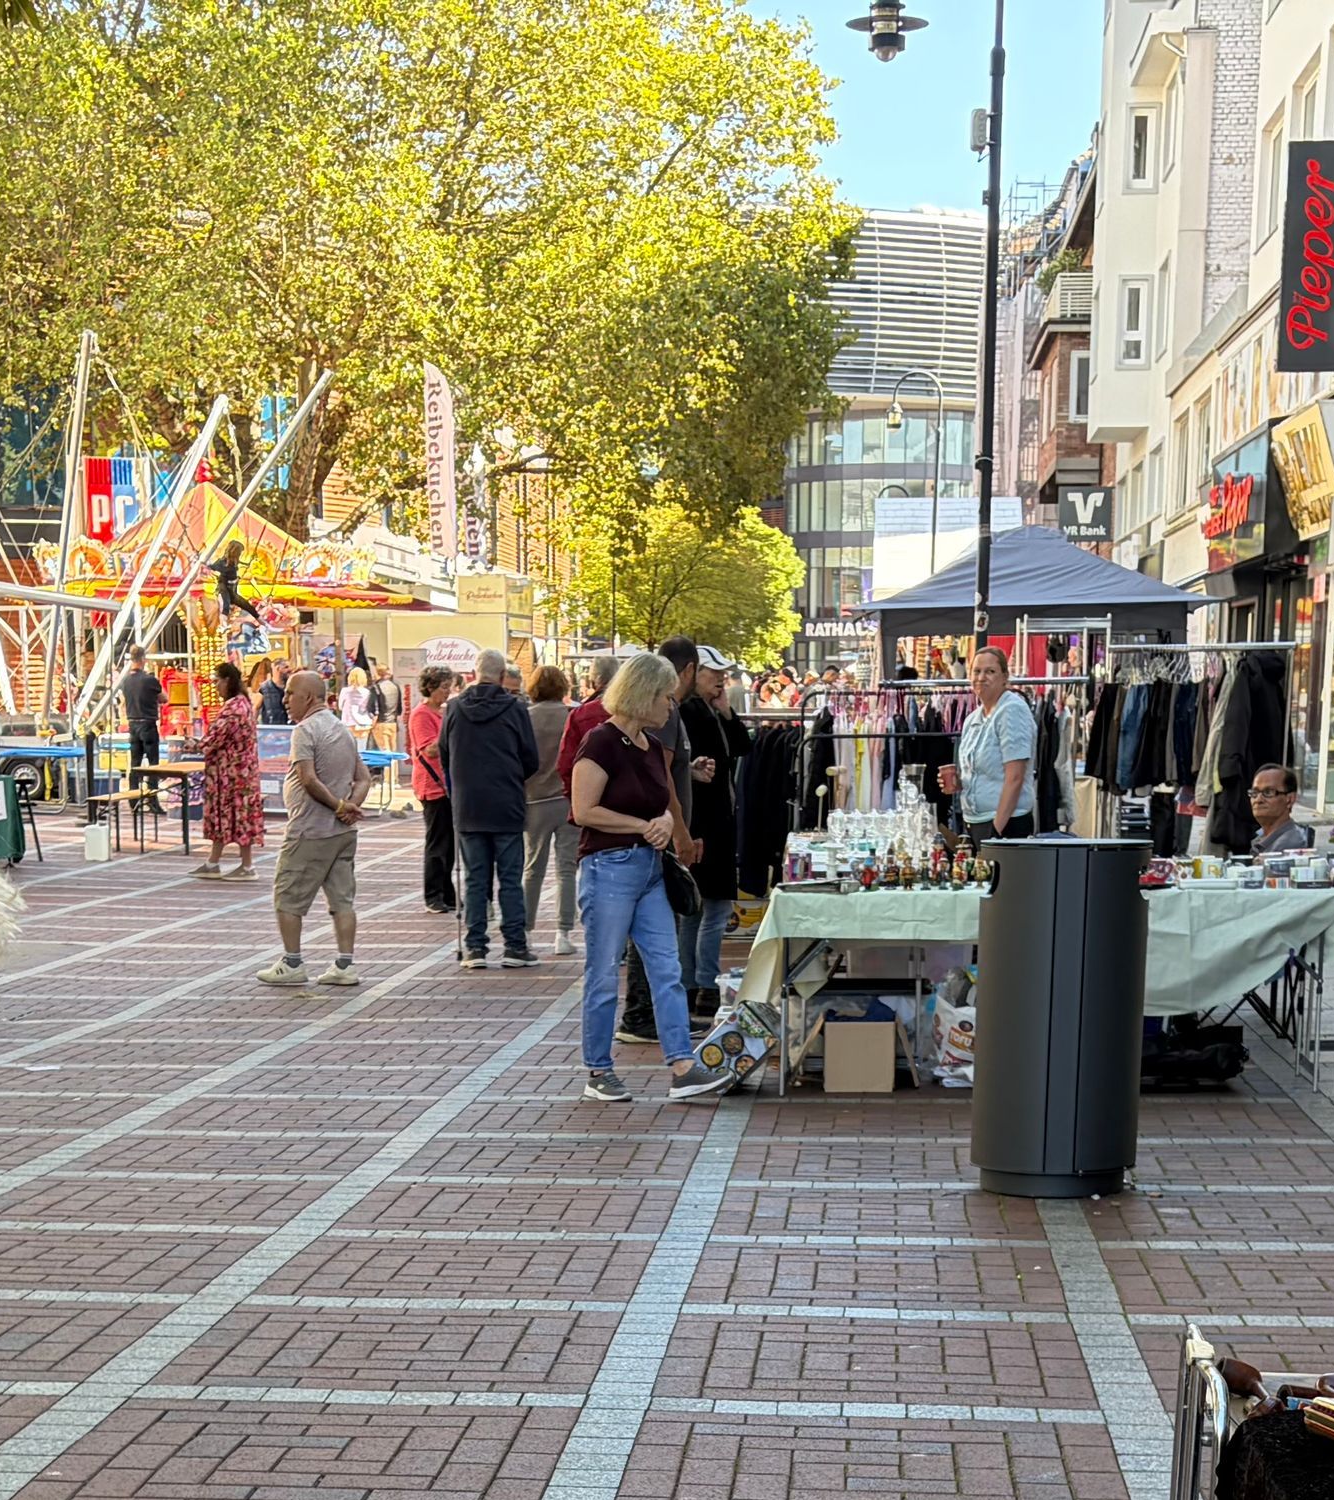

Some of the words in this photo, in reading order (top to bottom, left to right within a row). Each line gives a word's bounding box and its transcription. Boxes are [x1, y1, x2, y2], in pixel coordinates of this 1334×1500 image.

[427, 380, 446, 549] Reibekuchen
[1063, 526, 1078, 536] VR
[1080, 525, 1106, 536] Bank
